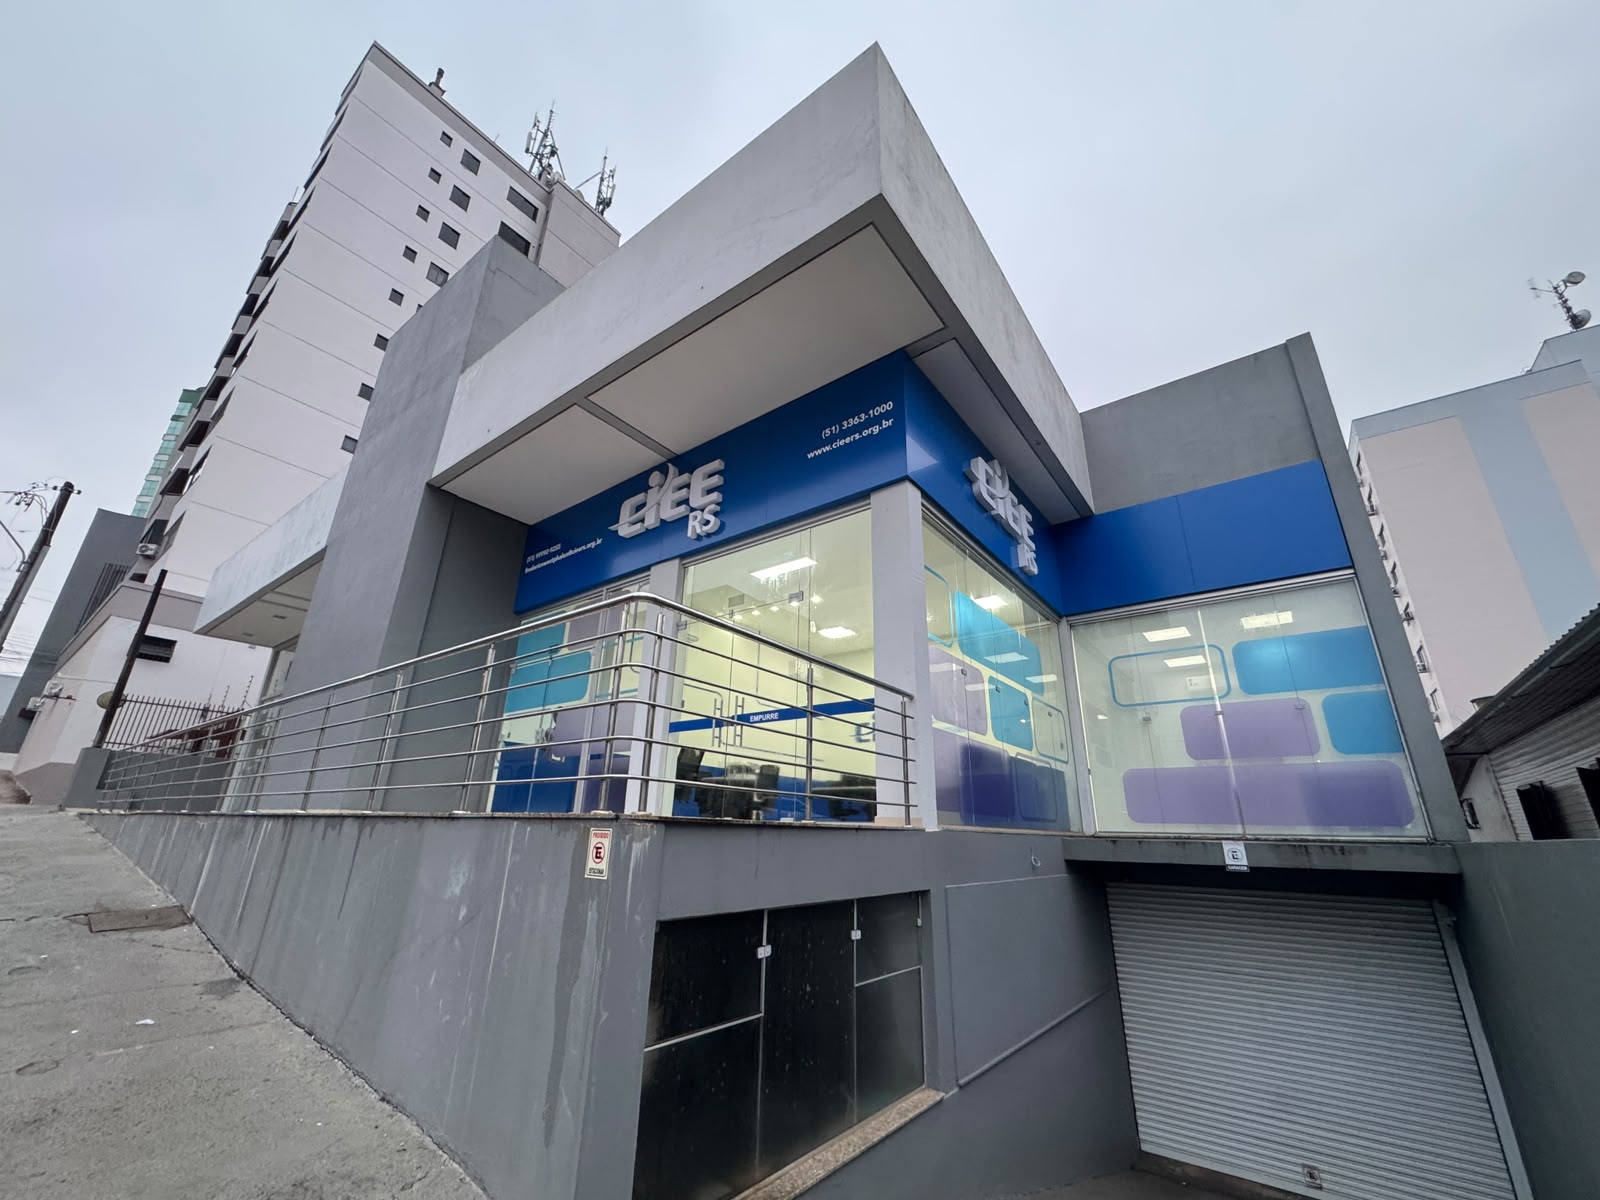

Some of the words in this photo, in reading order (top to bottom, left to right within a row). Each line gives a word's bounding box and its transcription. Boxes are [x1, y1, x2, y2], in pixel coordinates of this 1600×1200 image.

[807, 418, 894, 459] www.cieers.org.br
[821, 424, 840, 440] (51)
[841, 401, 894, 431] 3363-1000
[686, 503, 721, 540] RS
[749, 712, 780, 723] EMPURRE
